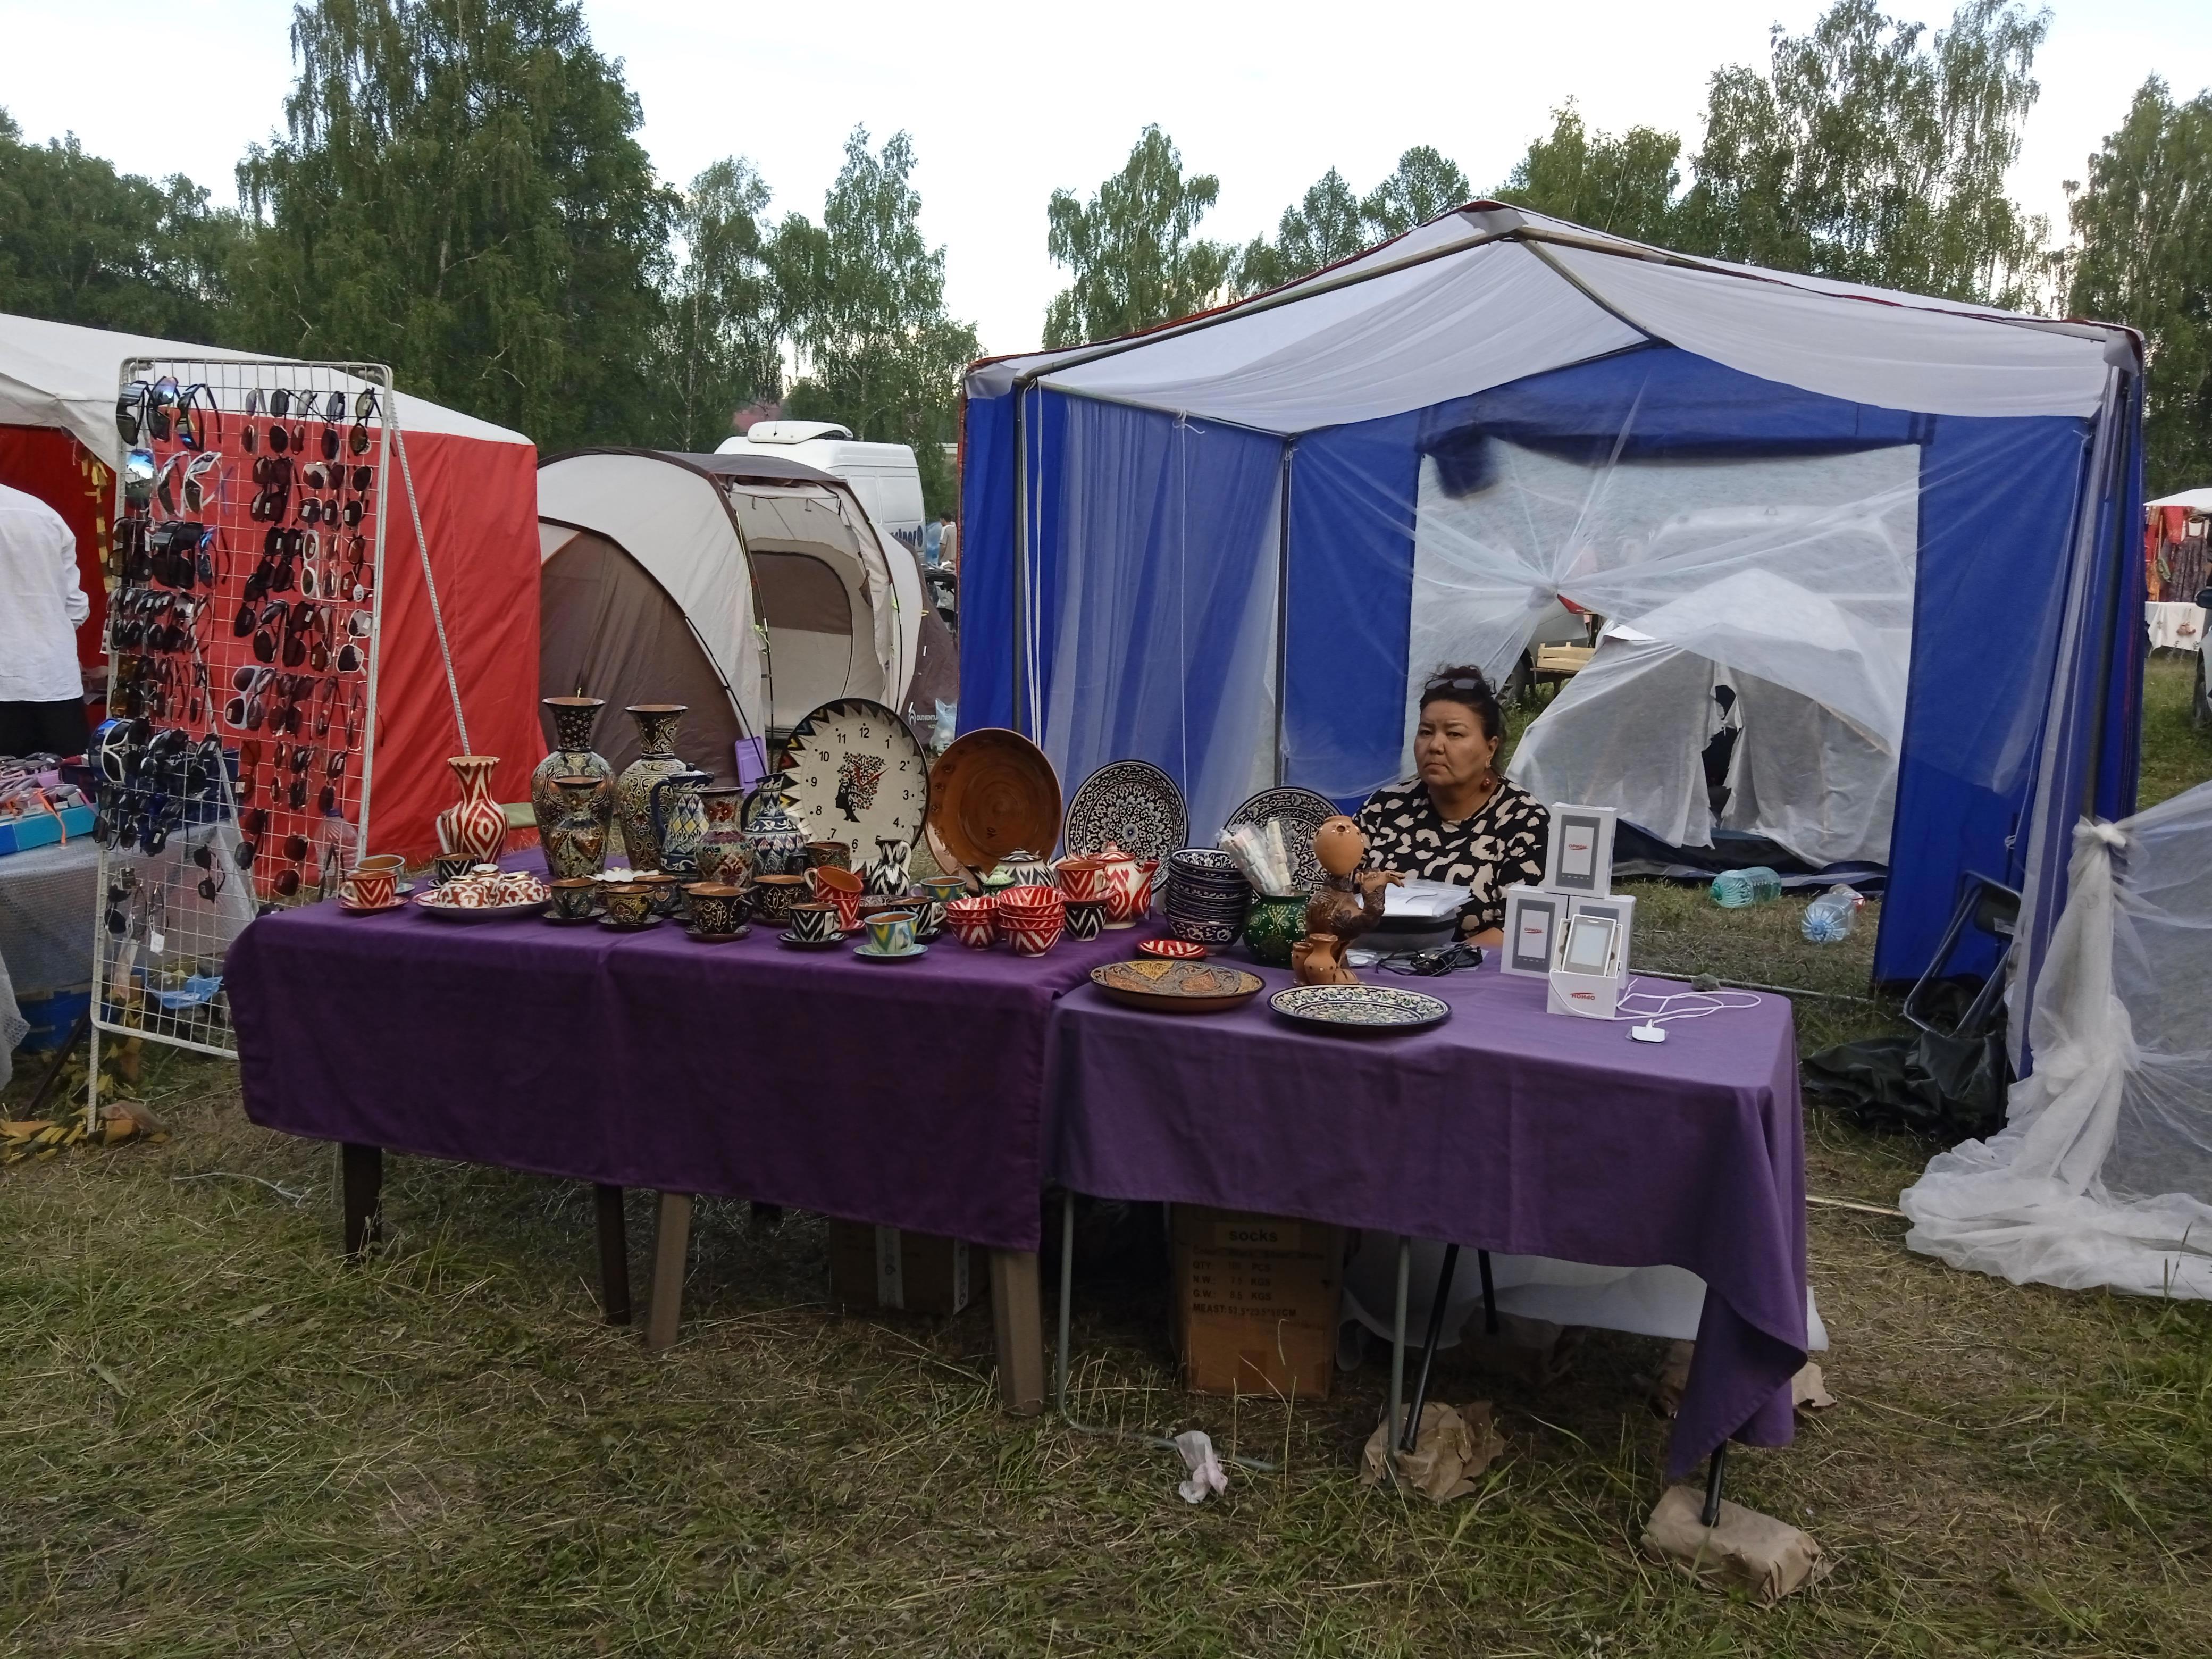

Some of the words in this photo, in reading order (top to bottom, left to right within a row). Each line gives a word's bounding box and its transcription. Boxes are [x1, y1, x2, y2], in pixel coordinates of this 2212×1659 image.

[859, 727, 869, 738] 12
[837, 733, 846, 744] 11
[885, 739, 890, 749] 1
[819, 751, 830, 761] 10
[900, 761, 906, 771] 2
[811, 777, 817, 787] 9
[903, 790, 909, 800] 3
[816, 805, 822, 815] 8
[893, 817, 900, 827] 4
[831, 828, 836, 839] 7
[852, 839, 858, 849] 6
[1251, 1278, 1271, 1286] KGS
[1251, 1292, 1272, 1301] KGS
